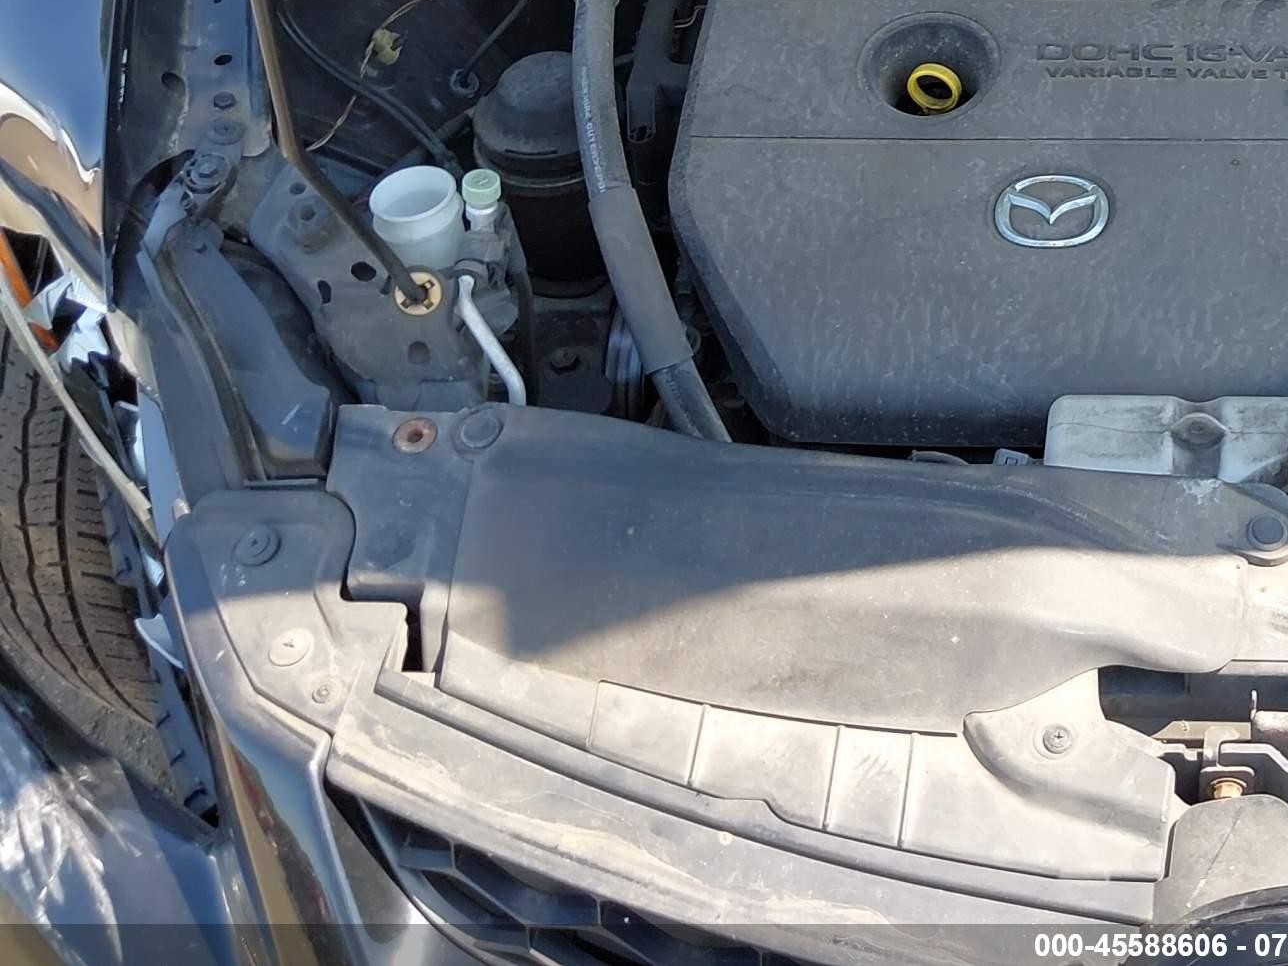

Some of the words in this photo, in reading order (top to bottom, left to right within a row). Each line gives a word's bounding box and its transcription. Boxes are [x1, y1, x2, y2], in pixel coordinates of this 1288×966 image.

[1036, 43, 1175, 62] DOHC
[1045, 66, 1178, 79] VARIABLE
[1185, 67, 1269, 80] VALVE
